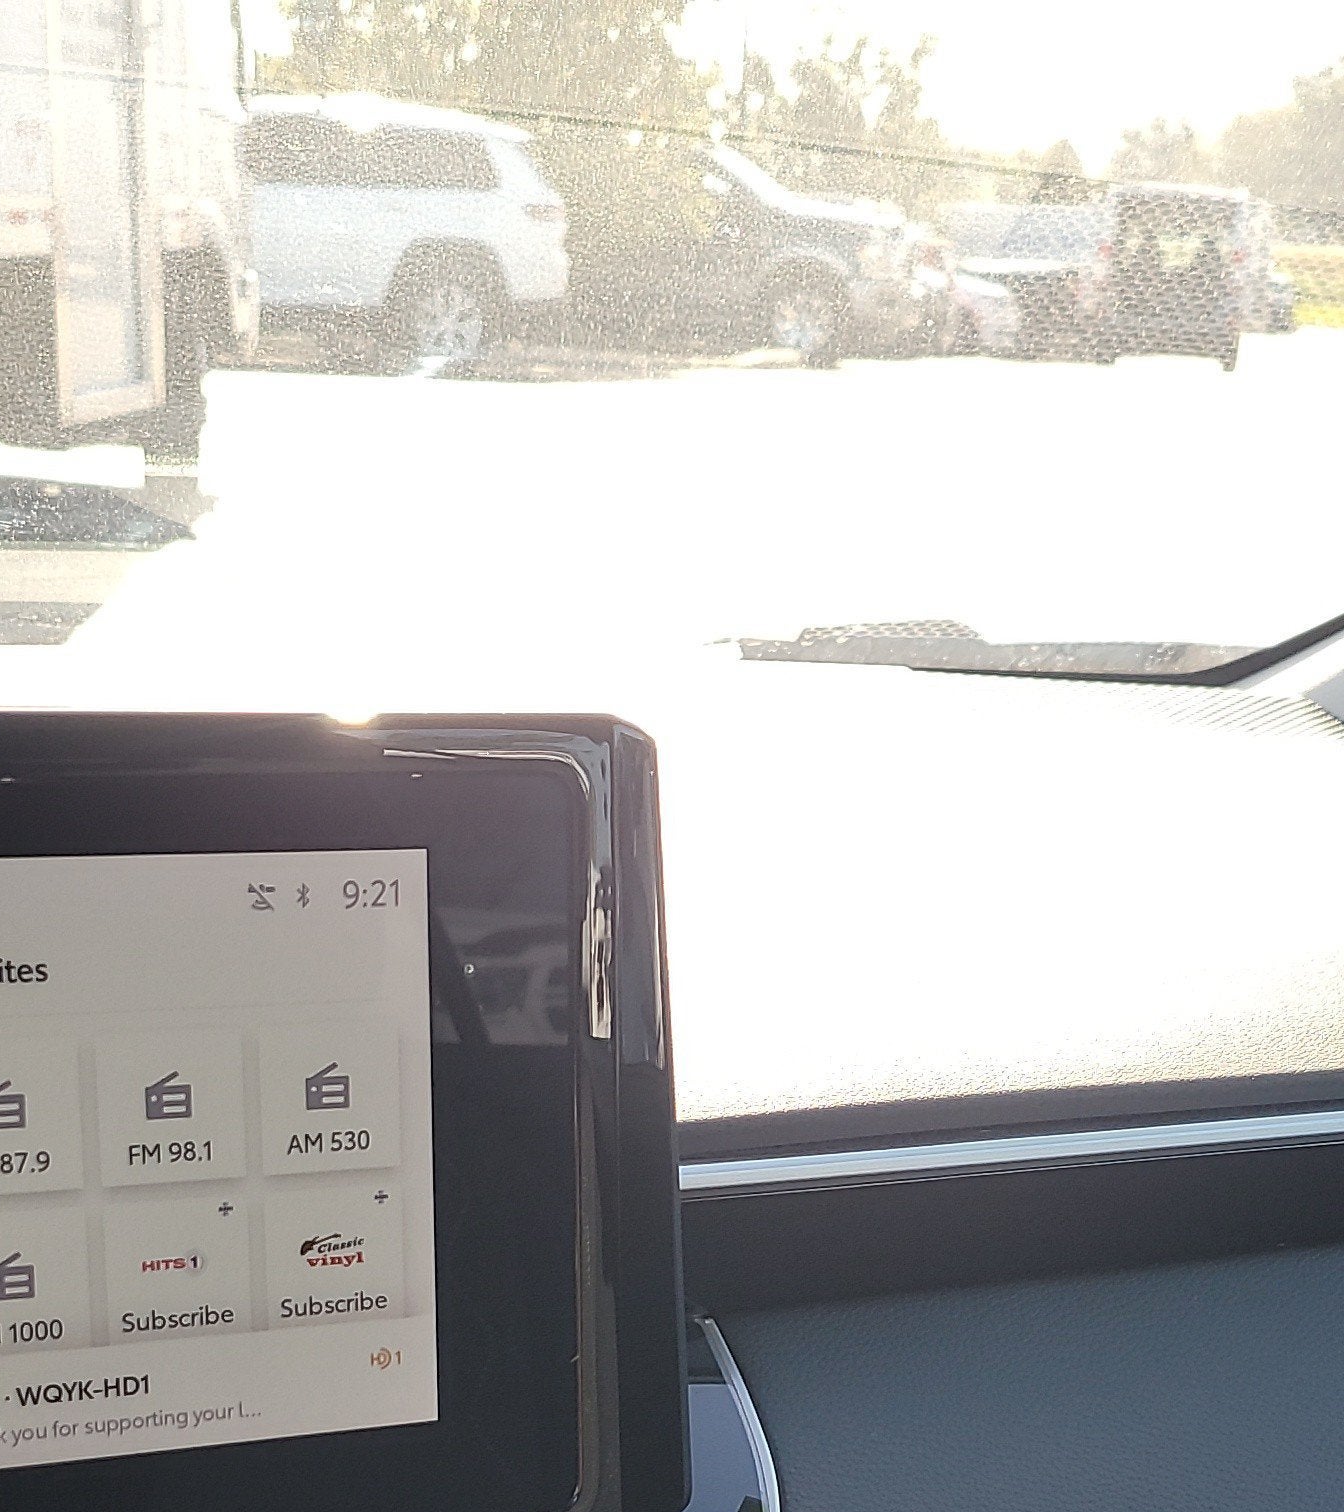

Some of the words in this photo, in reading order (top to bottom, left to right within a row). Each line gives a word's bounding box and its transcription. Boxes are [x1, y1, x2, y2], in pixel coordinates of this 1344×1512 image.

[343, 879, 398, 909] 9:21
[129, 1144, 160, 1165] FM
[169, 1141, 211, 1162] 98.1
[287, 1133, 322, 1155] AM
[331, 1130, 369, 1151] 530
[0, 1151, 50, 1174] 87.9
[317, 1237, 365, 1255] Classic
[141, 1257, 186, 1273] HITS
[306, 1251, 365, 1268] vinyl
[281, 1291, 387, 1318] Subscribe
[122, 1305, 233, 1332] Subscribe
[9, 1319, 62, 1343] 1000
[16, 1375, 150, 1406] WQYK-HD1
[11, 1424, 48, 1448] you
[52, 1417, 79, 1438] for
[84, 1406, 189, 1436] supporting
[192, 1403, 234, 1428] your
